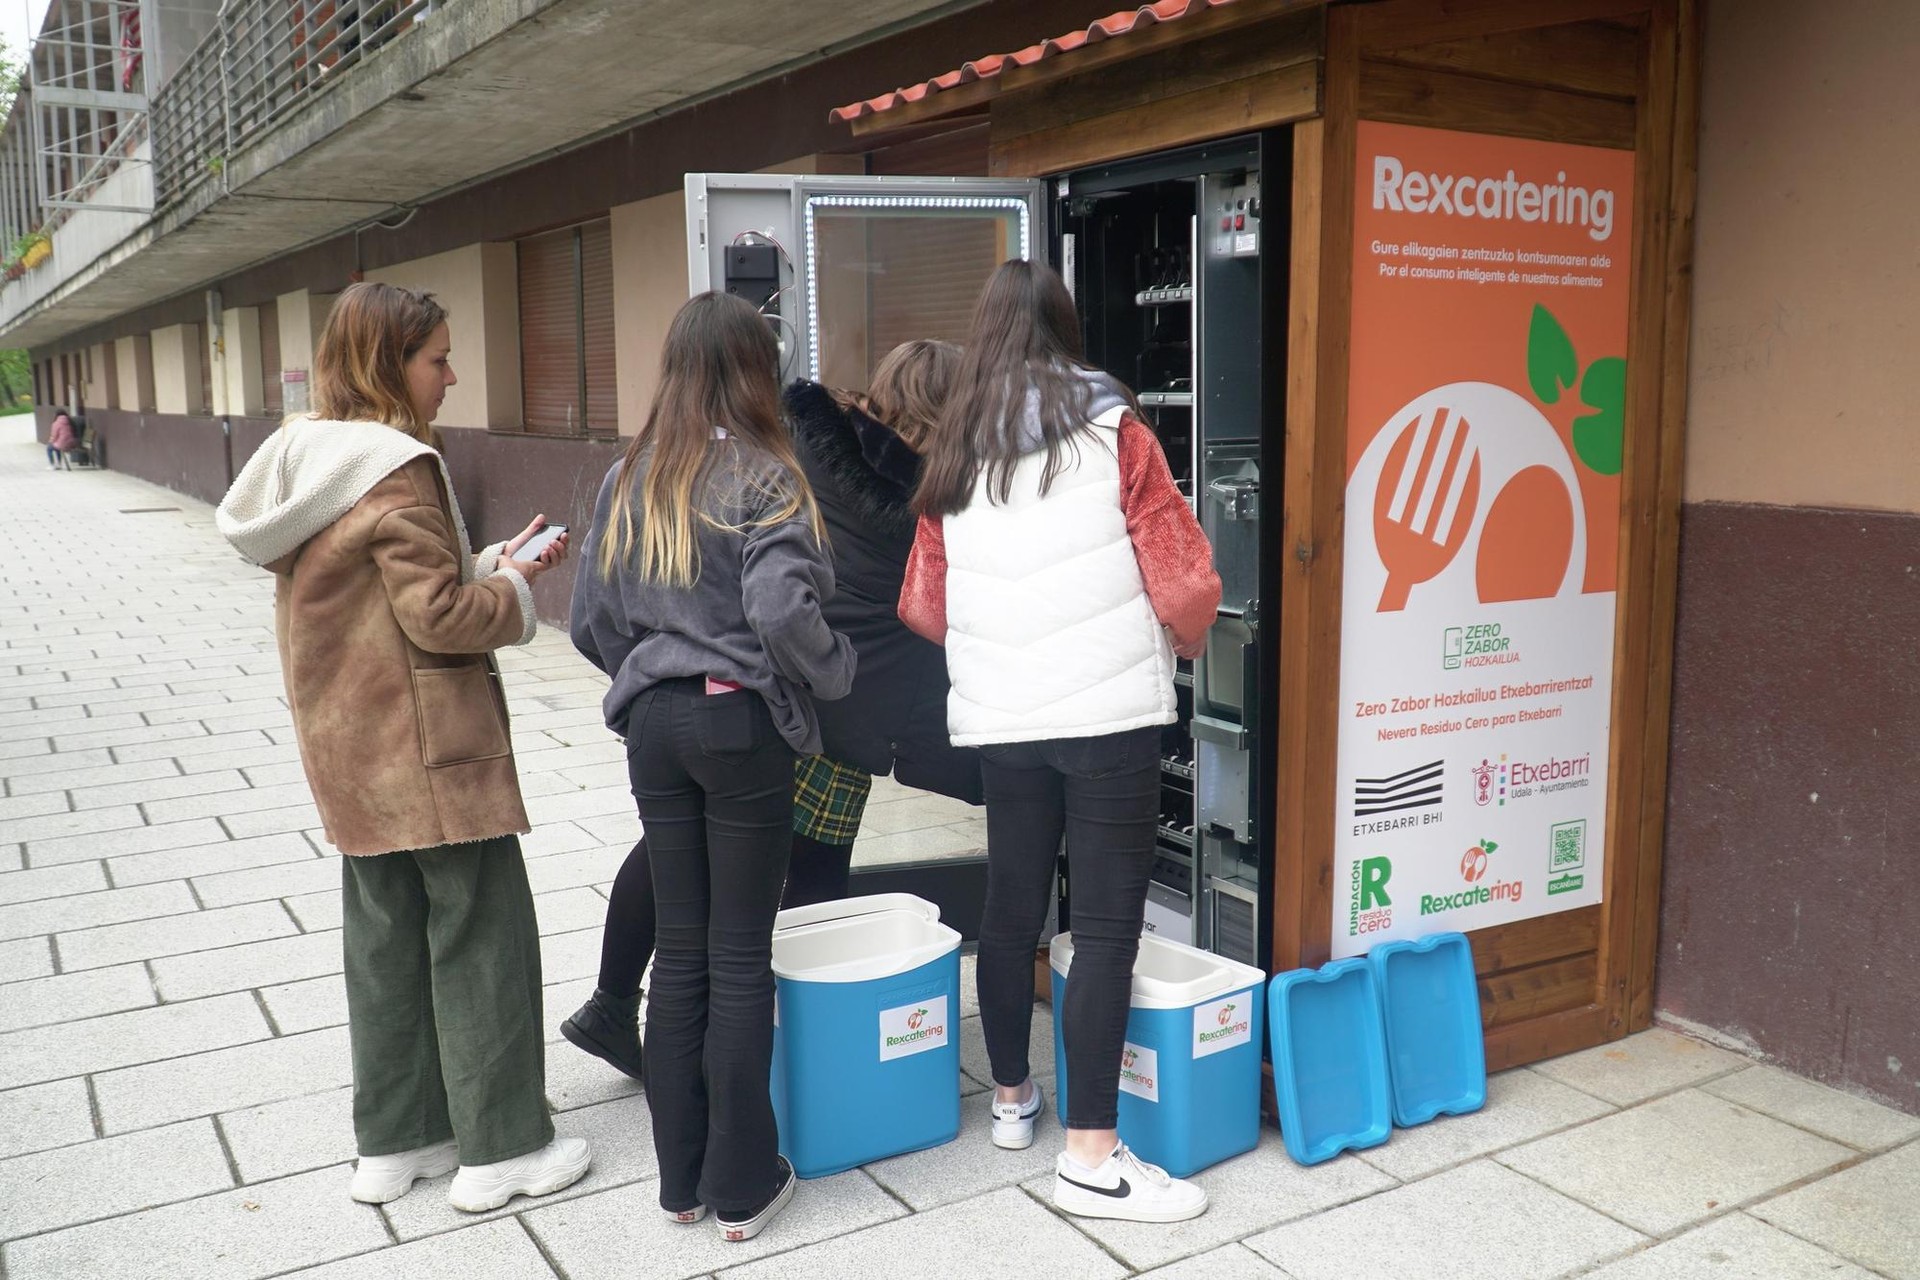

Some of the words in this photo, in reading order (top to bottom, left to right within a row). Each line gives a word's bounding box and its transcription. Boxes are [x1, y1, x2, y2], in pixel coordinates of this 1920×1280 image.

[1372, 155, 1614, 241] Rexcatering
[1371, 240, 1399, 255] Gure
[1402, 242, 1459, 260] elikagaien
[1462, 247, 1514, 262] zentzuzko
[1517, 249, 1587, 267] kontsumoaren
[1590, 254, 1611, 268] alde
[1380, 263, 1397, 276] Por
[1399, 264, 1408, 277] el
[1411, 267, 1455, 279] consumo
[1458, 267, 1506, 284] inteligente
[1508, 270, 1520, 283] de
[1522, 273, 1559, 285] nuestros
[1561, 274, 1603, 287] alimentos
[1465, 623, 1501, 639] ZERO
[1465, 638, 1510, 655] ZABOR
[1464, 652, 1521, 667] HOZKAILUA
[1355, 702, 1387, 718] Zero
[1391, 695, 1431, 713] Zabor
[1434, 687, 1497, 707] Hozkailua
[1500, 675, 1593, 699] Etxebarrirentzat
[1378, 728, 1417, 741] Nevera
[1420, 720, 1462, 735] Residuo
[1465, 717, 1489, 730] Cero
[1492, 713, 1516, 729] para
[1519, 704, 1562, 722] Etxebarri
[1511, 752, 1590, 786] Etxebarri
[1511, 787, 1532, 799] Udala
[1540, 778, 1589, 795] Ayuntamiento
[1353, 816, 1419, 836] ETXEBARRI
[1423, 811, 1443, 825] BHI
[1360, 856, 1392, 911] R
[1350, 860, 1360, 936] FUNDACIÓN
[1420, 879, 1522, 916] Rexcatering
[1359, 908, 1392, 921] residuo
[1359, 917, 1391, 934] cero
[886, 1025, 943, 1047] Rexcatering
[1199, 1022, 1248, 1043] Rexcatering
[1120, 1069, 1153, 1089] catering
